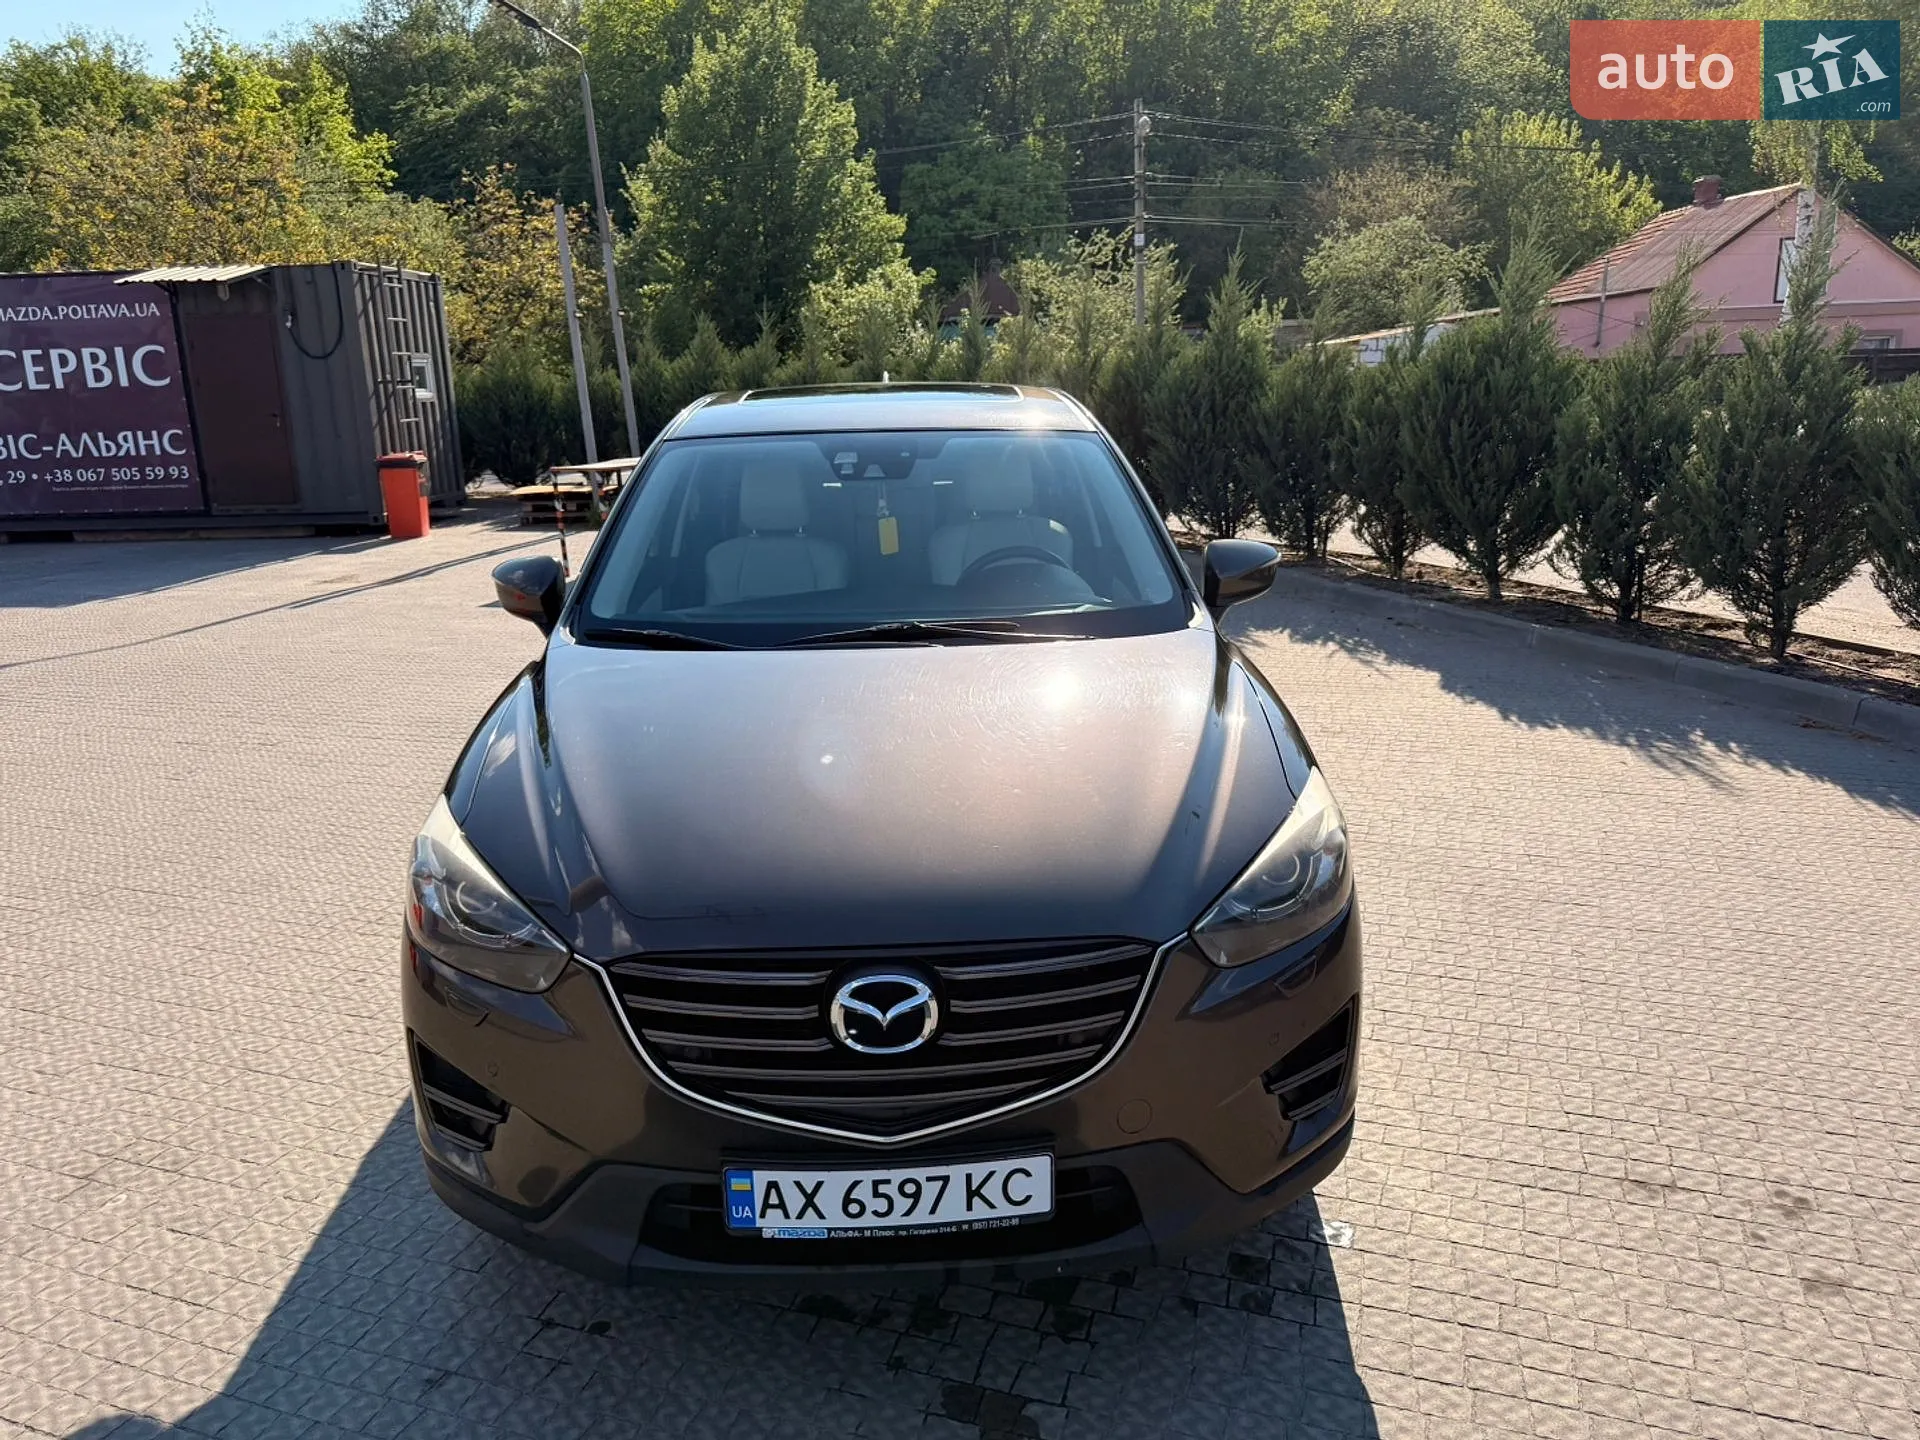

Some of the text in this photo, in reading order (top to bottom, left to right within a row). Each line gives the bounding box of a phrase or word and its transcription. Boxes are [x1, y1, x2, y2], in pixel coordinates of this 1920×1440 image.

[6, 470, 26, 484] 29
[44, 469, 73, 483] +38
[77, 468, 105, 482] 067
[111, 467, 141, 481] 505
[145, 466, 165, 480] 59
[169, 465, 190, 479] 93
[759, 1167, 1033, 1220] AX 6597 KC
[732, 1205, 753, 1218] UA
